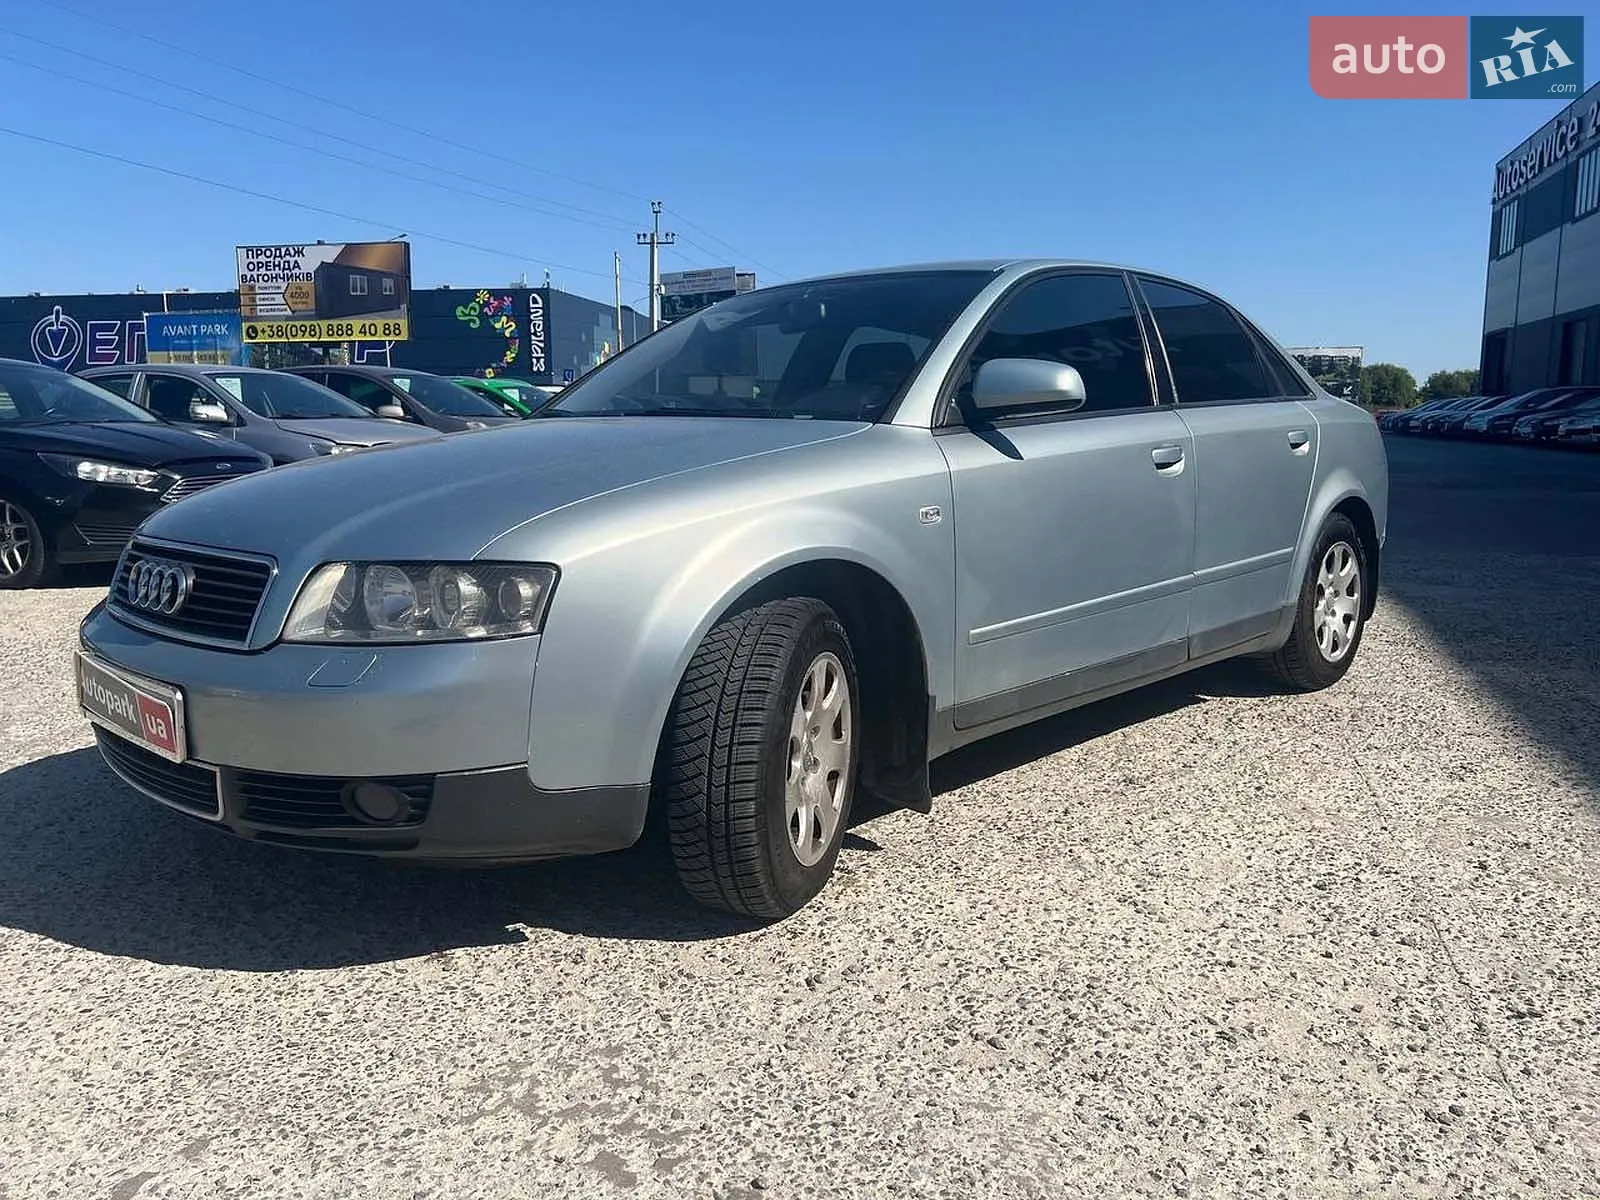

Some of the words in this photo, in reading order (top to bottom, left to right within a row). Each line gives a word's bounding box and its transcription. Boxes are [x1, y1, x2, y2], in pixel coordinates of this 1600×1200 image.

[1493, 117, 1579, 201] Autoservice
[1587, 101, 1600, 138] 2
[246, 246, 305, 260] ПРОДАЖ
[246, 260, 302, 272] ОРЕНДА
[240, 271, 313, 283] ВАГОНЧИКІВ
[162, 324, 198, 337] AVANT
[200, 323, 229, 336] PARK
[260, 322, 322, 340] +38(098)
[326, 323, 354, 336] 888
[358, 322, 378, 336] 40
[382, 322, 402, 336] 88
[145, 712, 168, 741] ua
